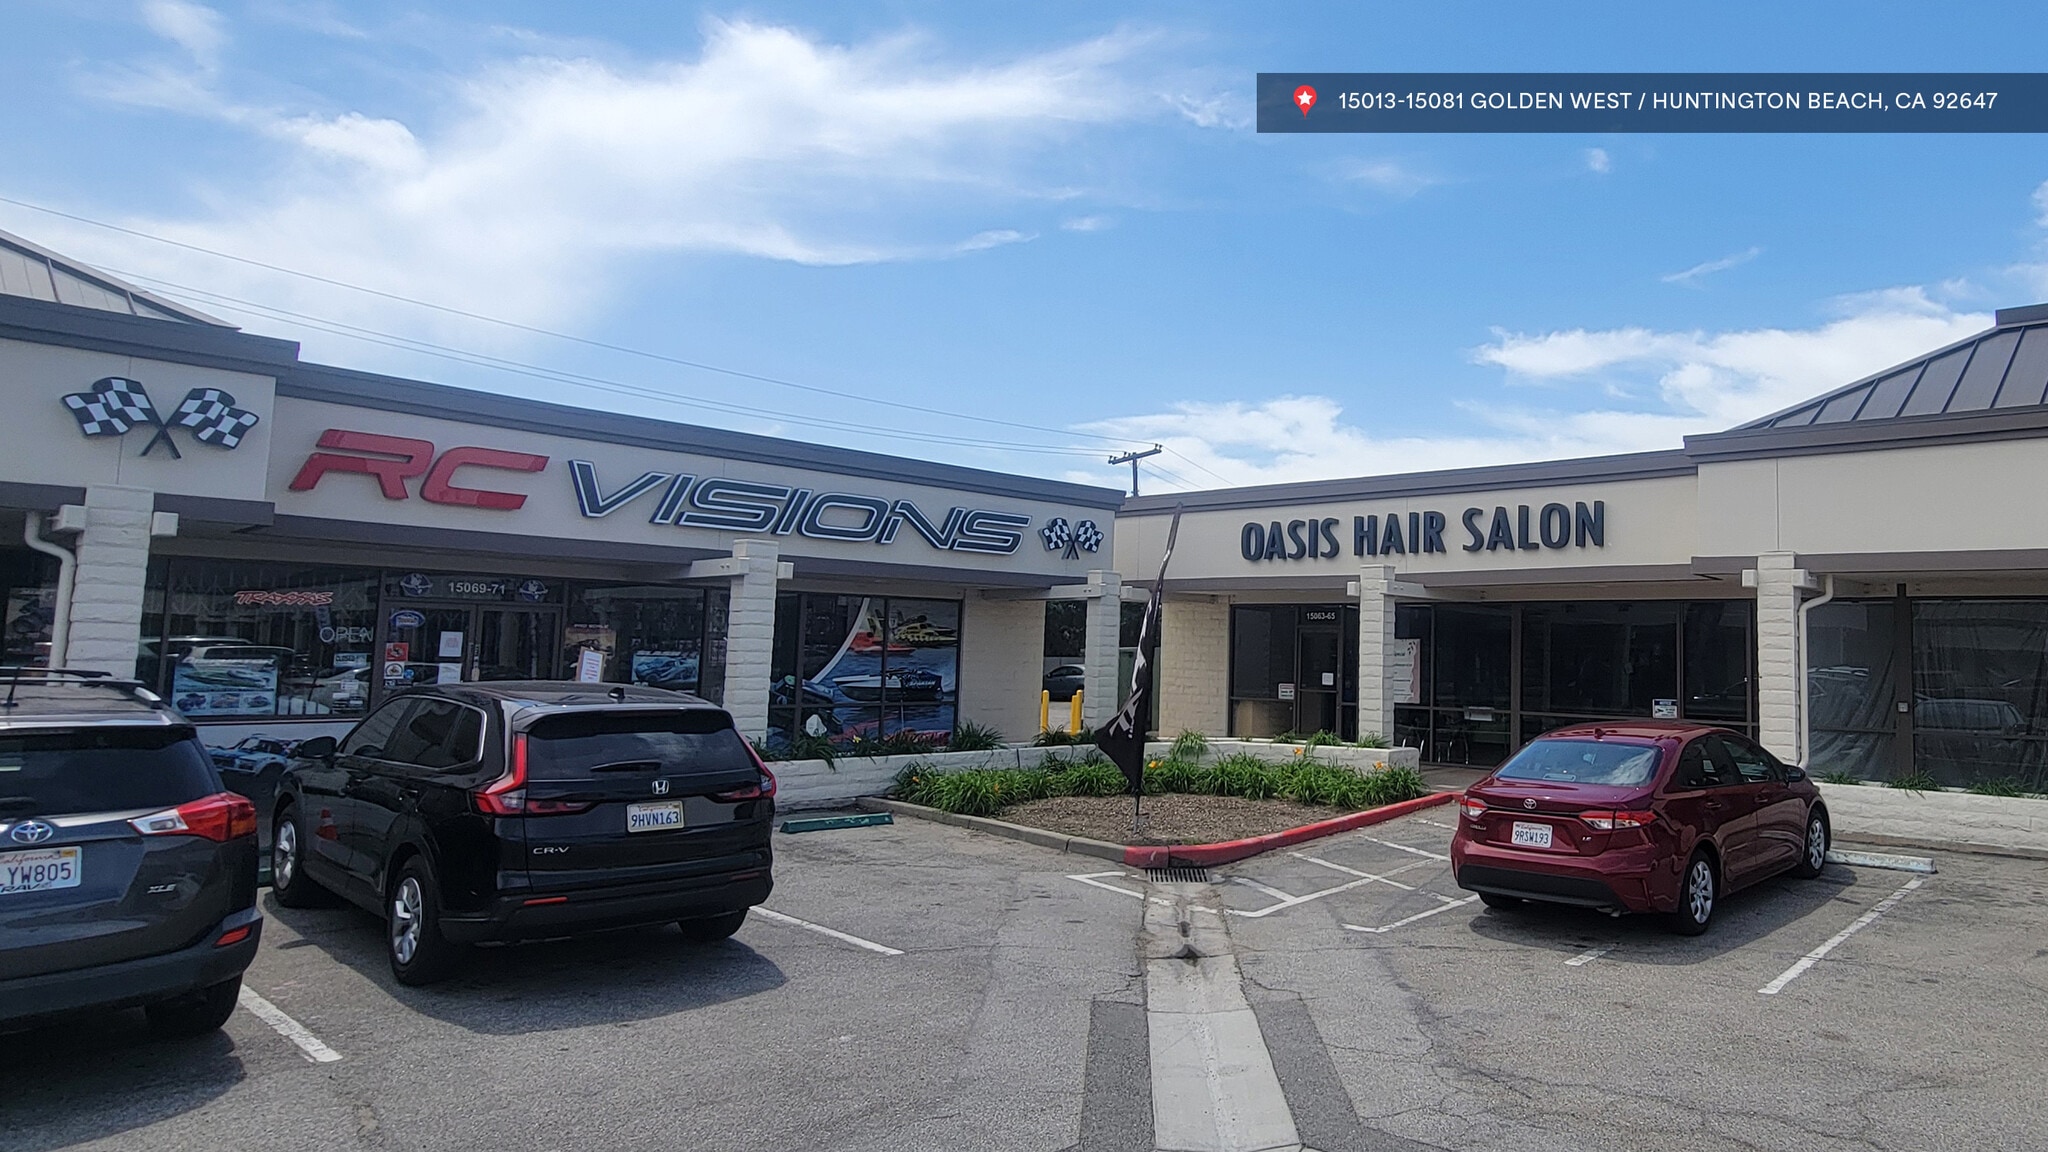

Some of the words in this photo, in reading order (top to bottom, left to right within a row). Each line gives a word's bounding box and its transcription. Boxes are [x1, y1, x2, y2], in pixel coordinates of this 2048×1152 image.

[288, 428, 550, 511] RC
[568, 458, 1033, 555] VISIONS
[1240, 517, 1340, 562] OASIS
[1353, 510, 1447, 557] HAIR
[1462, 500, 1605, 553] SALON
[448, 581, 506, 596] 15069-71
[233, 590, 334, 606] TRAXXAS
[1306, 612, 1336, 621] 15063-65
[319, 626, 374, 643] OPEN
[631, 810, 680, 828] 9HVN163
[1514, 830, 1550, 844] 9RSW193
[0, 861, 72, 887] YW805
[147, 883, 177, 894] XLE
